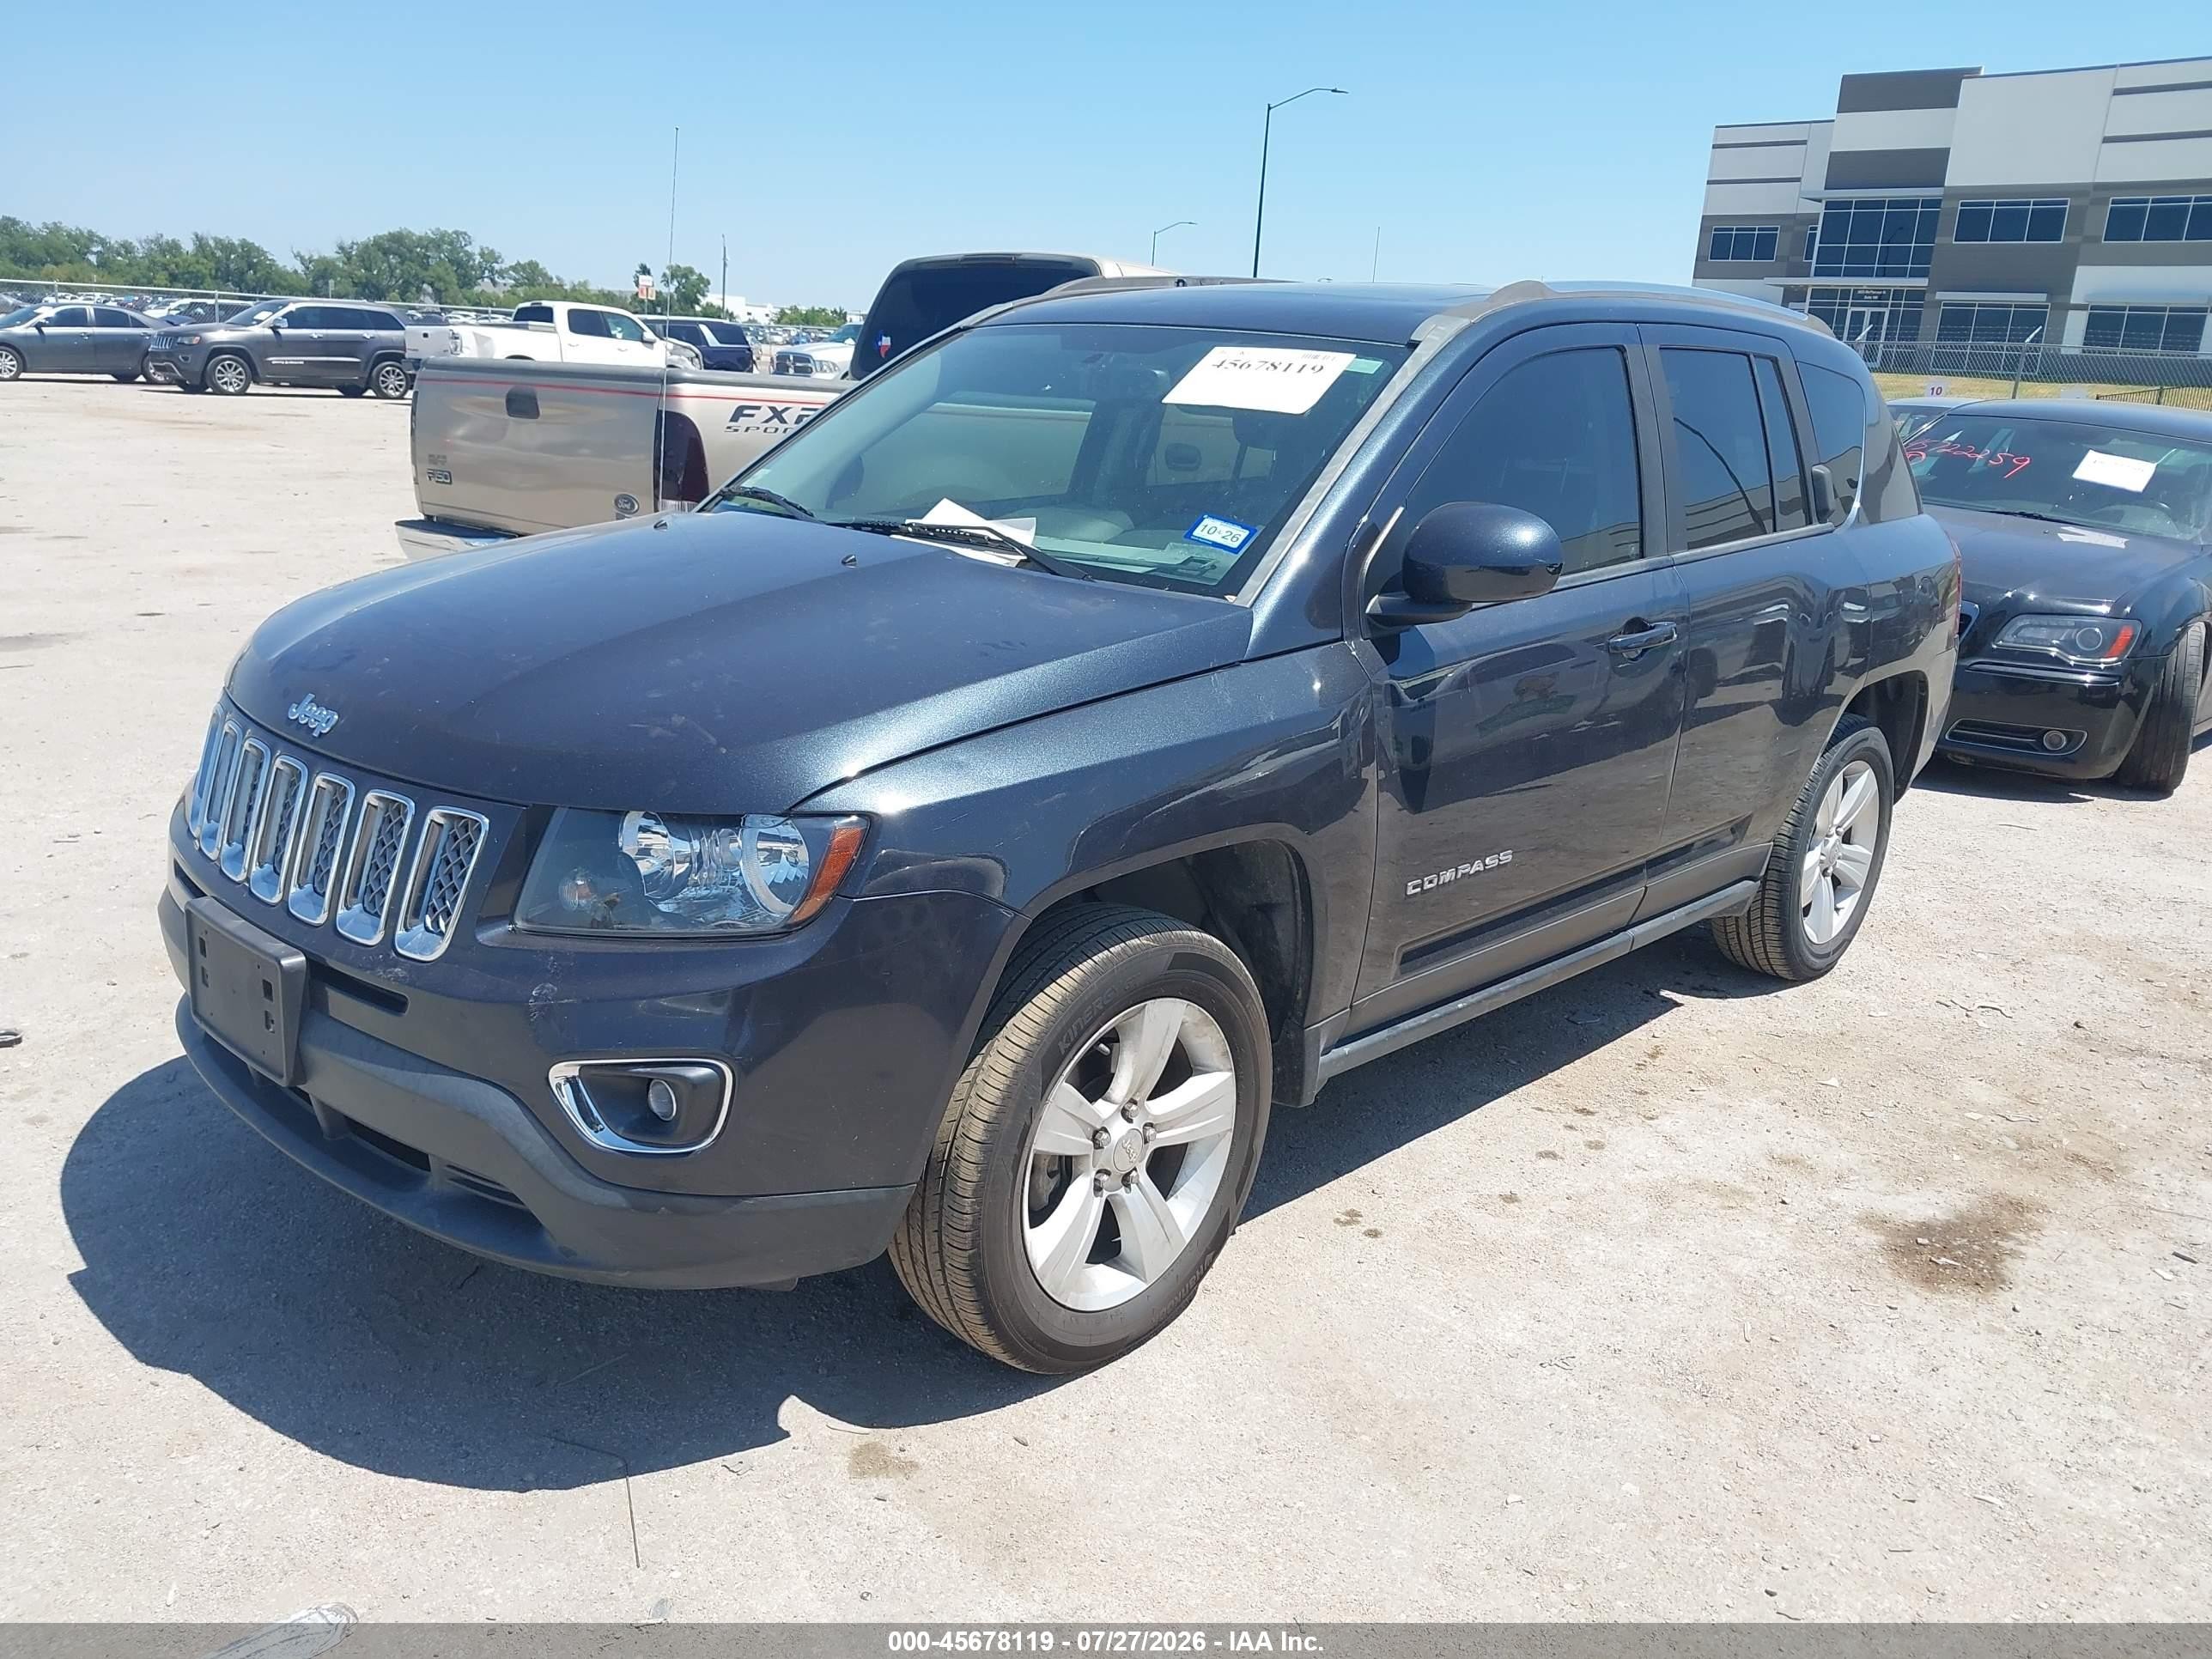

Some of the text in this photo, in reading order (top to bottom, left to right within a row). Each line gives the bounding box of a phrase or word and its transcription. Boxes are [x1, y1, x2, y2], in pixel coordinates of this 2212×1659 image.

[1212, 359, 1324, 374] 45678119
[1929, 386, 1942, 396] 10
[289, 693, 339, 737] Jeep
[1406, 849, 1513, 896] COMPASS
